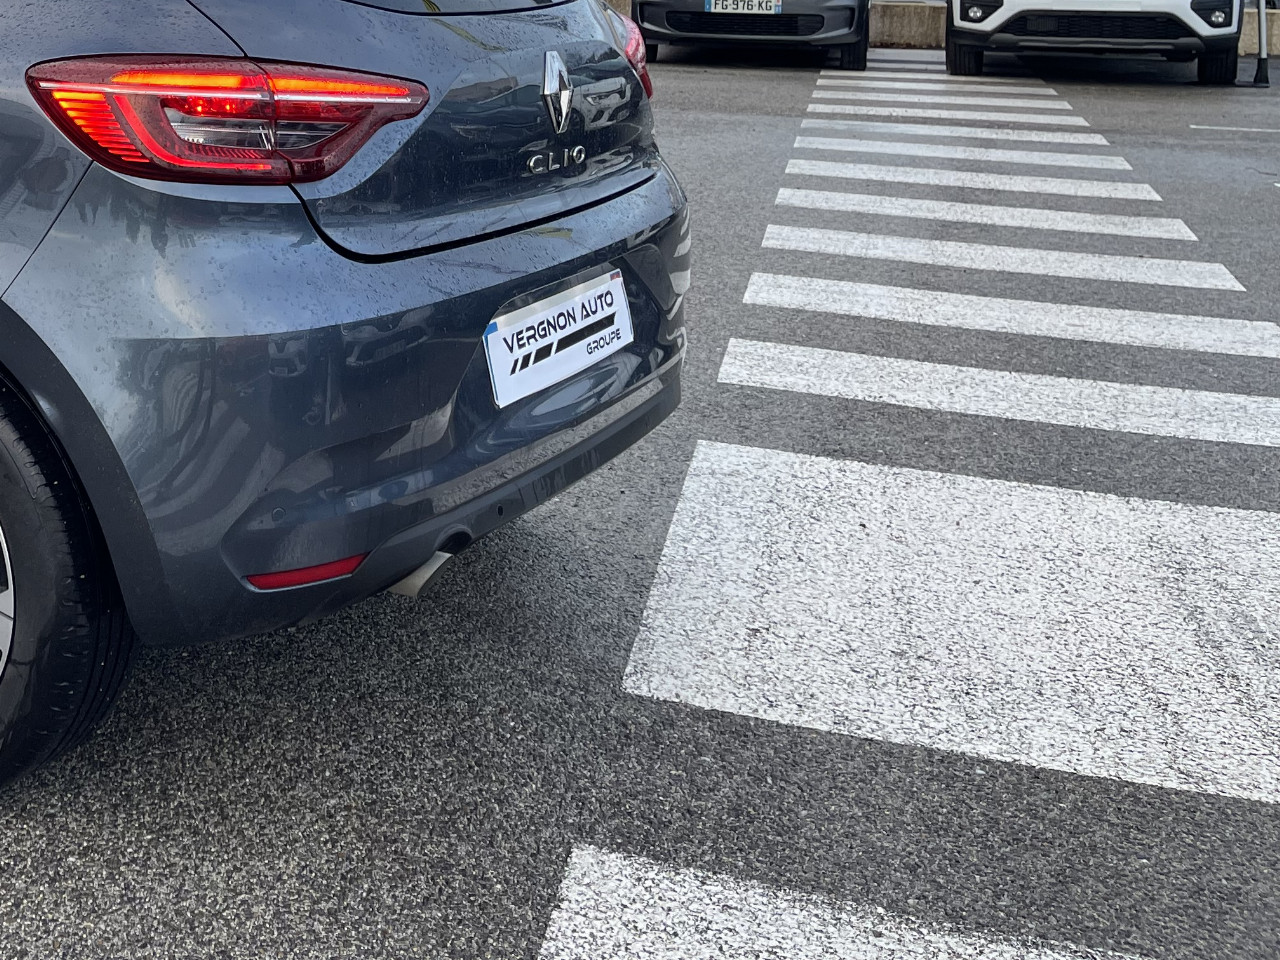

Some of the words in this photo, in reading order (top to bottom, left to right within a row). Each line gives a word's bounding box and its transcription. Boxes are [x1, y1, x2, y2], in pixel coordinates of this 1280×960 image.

[527, 145, 586, 175] CLIO
[502, 306, 578, 354] VERGNON
[580, 289, 614, 322] AUTO
[586, 327, 622, 355] GROUPE
